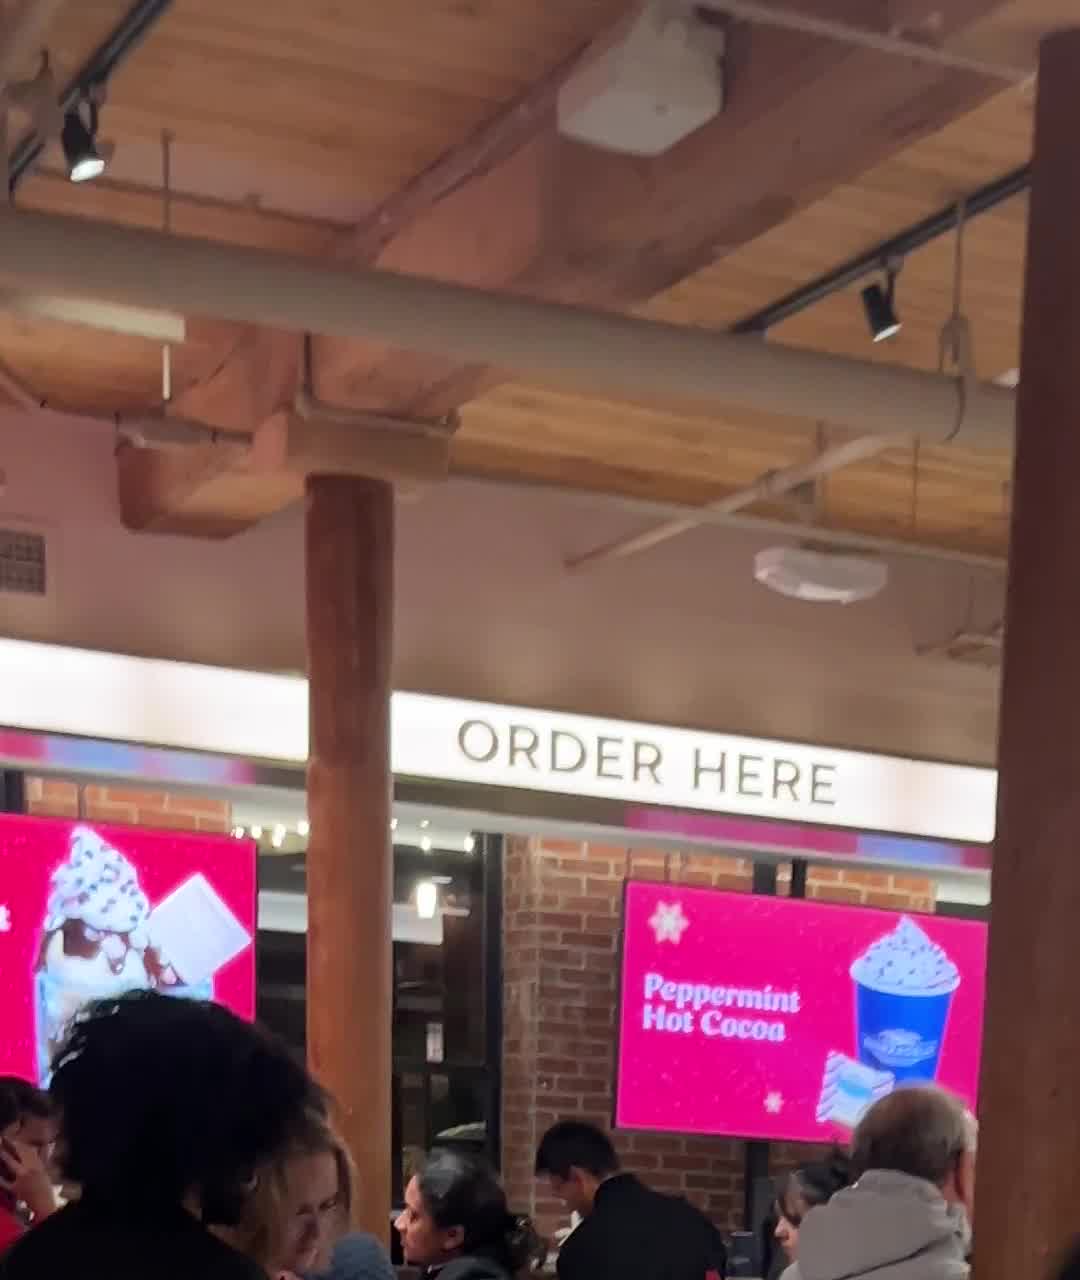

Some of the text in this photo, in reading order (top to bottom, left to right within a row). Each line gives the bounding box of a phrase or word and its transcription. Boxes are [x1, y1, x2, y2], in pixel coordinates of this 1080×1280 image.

[457, 719, 837, 806] ORDER HERE
[643, 971, 801, 1014] Peppermint
[642, 1003, 787, 1043] Hot Cocoa
